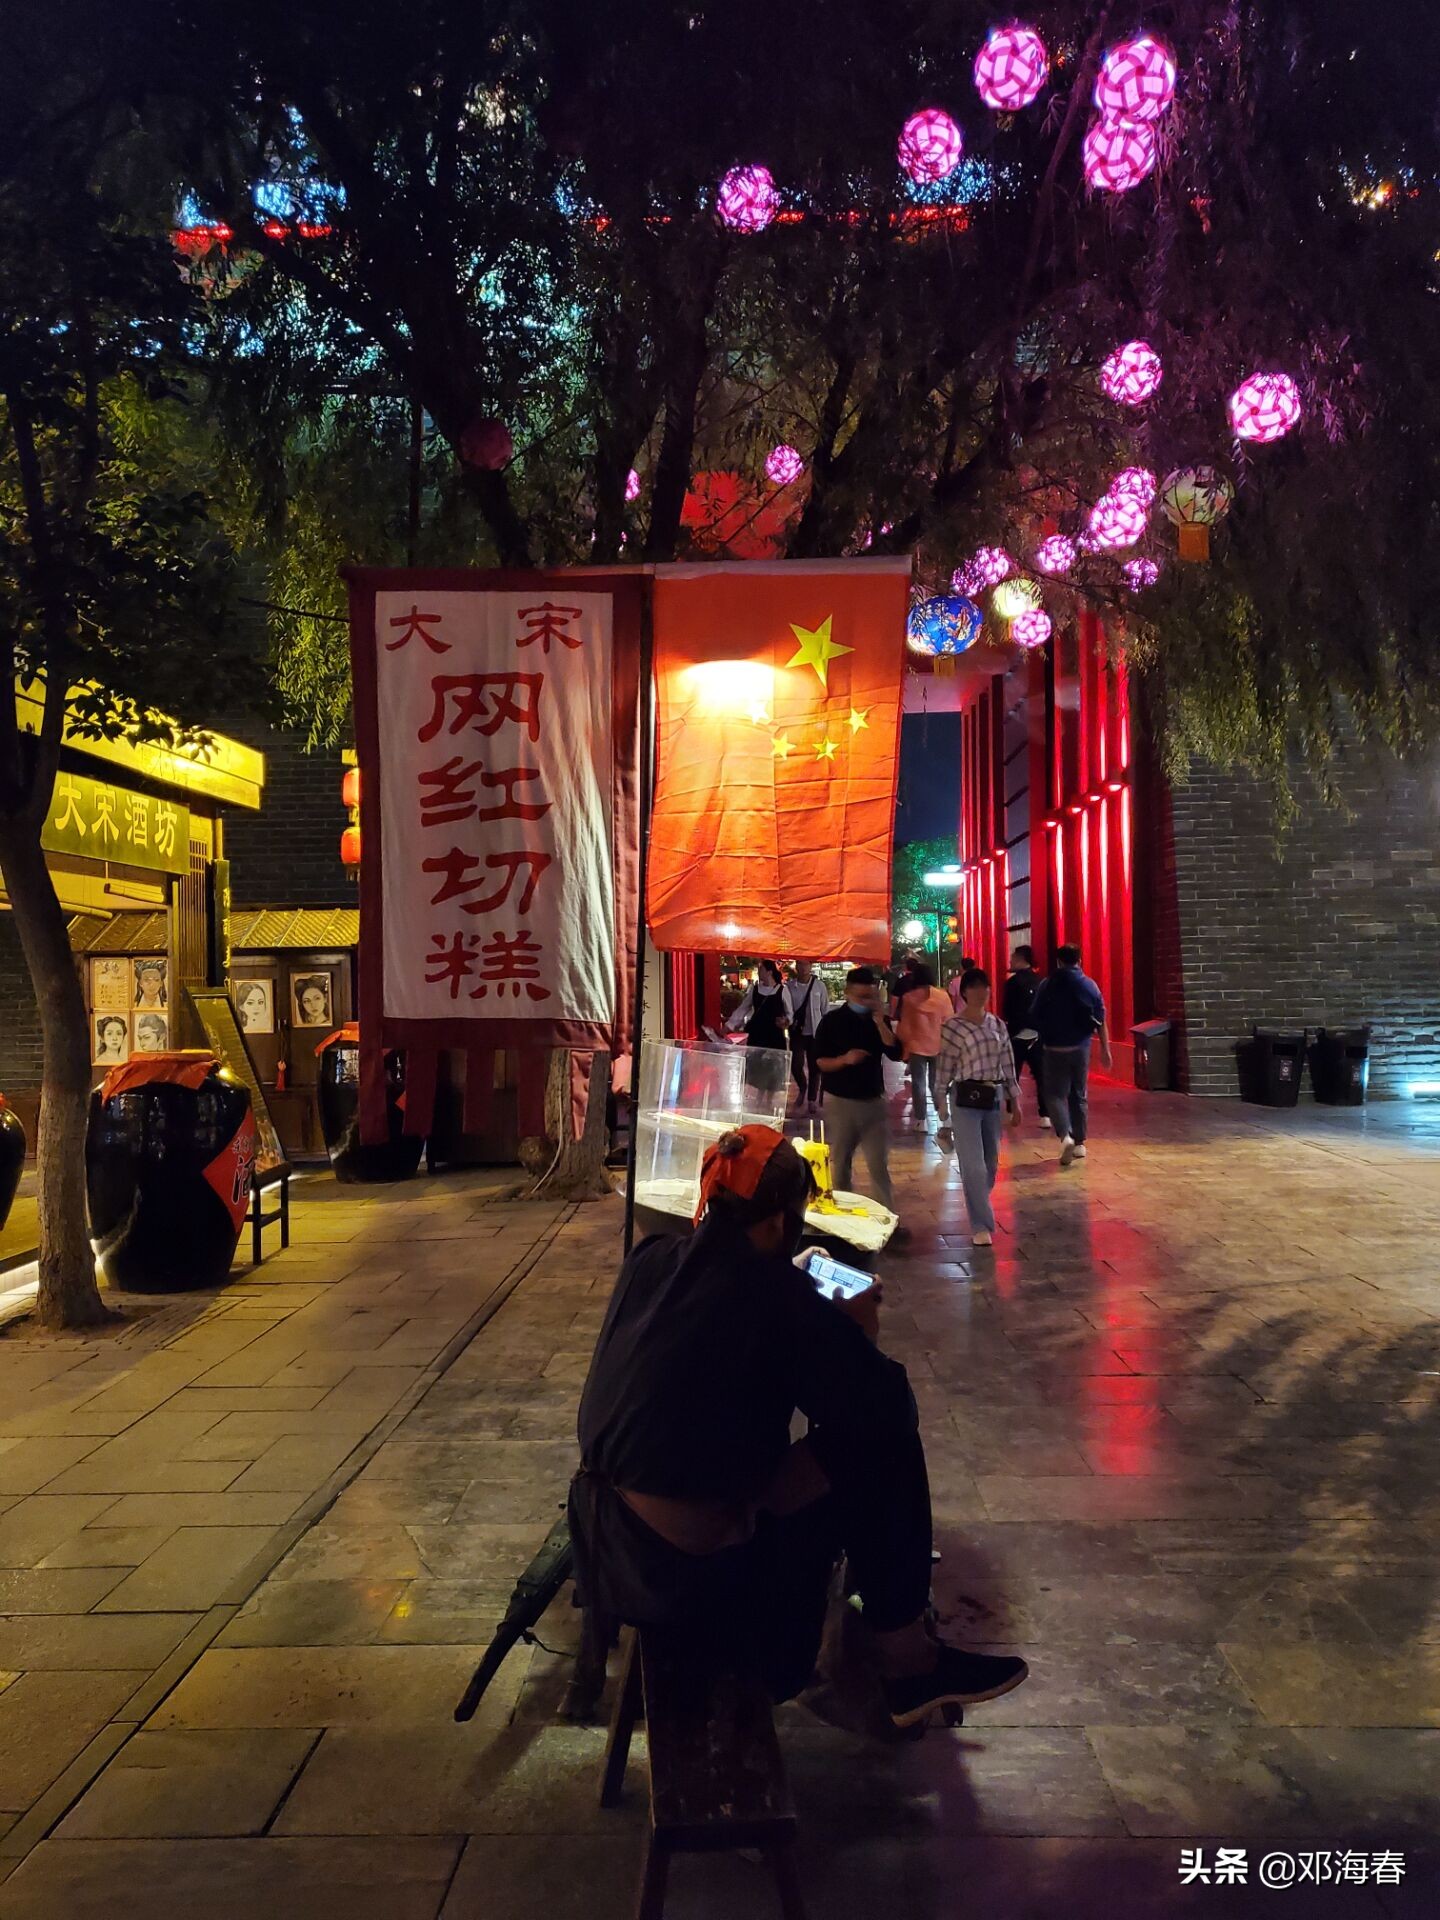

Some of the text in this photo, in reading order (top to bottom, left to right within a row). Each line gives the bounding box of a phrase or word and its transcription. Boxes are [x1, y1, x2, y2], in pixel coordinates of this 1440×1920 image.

[385, 601, 583, 654] 大宋
[54, 774, 178, 858] 大宋酒坊
[418, 672, 553, 1000] 网红切糕
